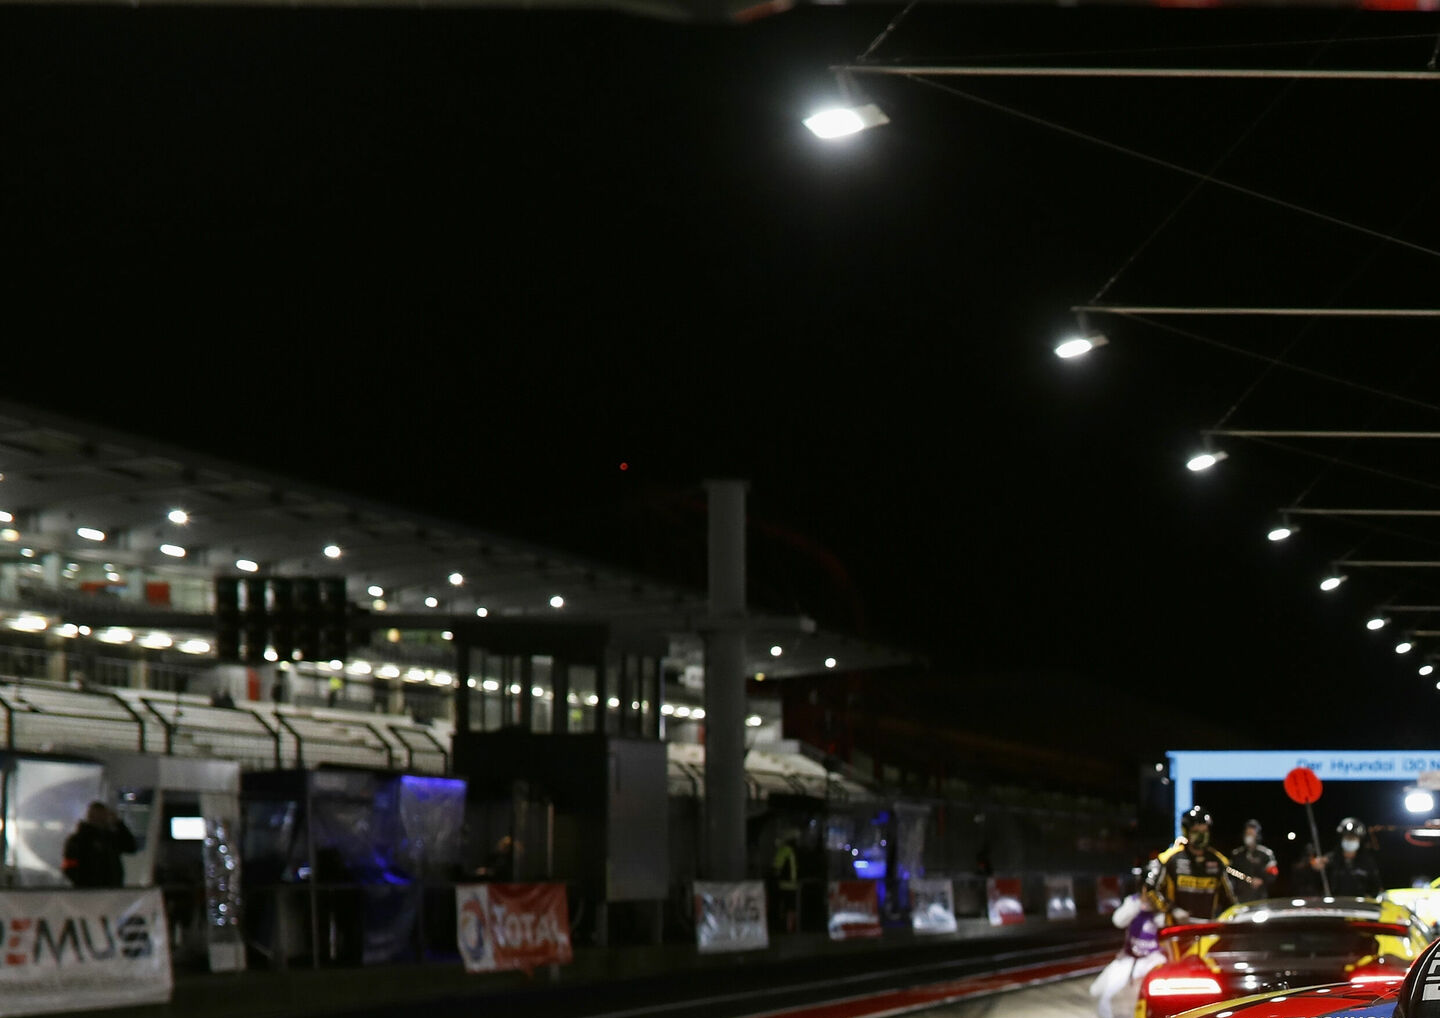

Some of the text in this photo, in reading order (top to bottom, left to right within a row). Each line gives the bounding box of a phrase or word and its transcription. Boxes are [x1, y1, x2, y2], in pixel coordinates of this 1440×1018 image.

[1331, 757, 1394, 773] Hyundai
[1403, 758, 1427, 771] i30
[0, 915, 154, 966] EMUS
